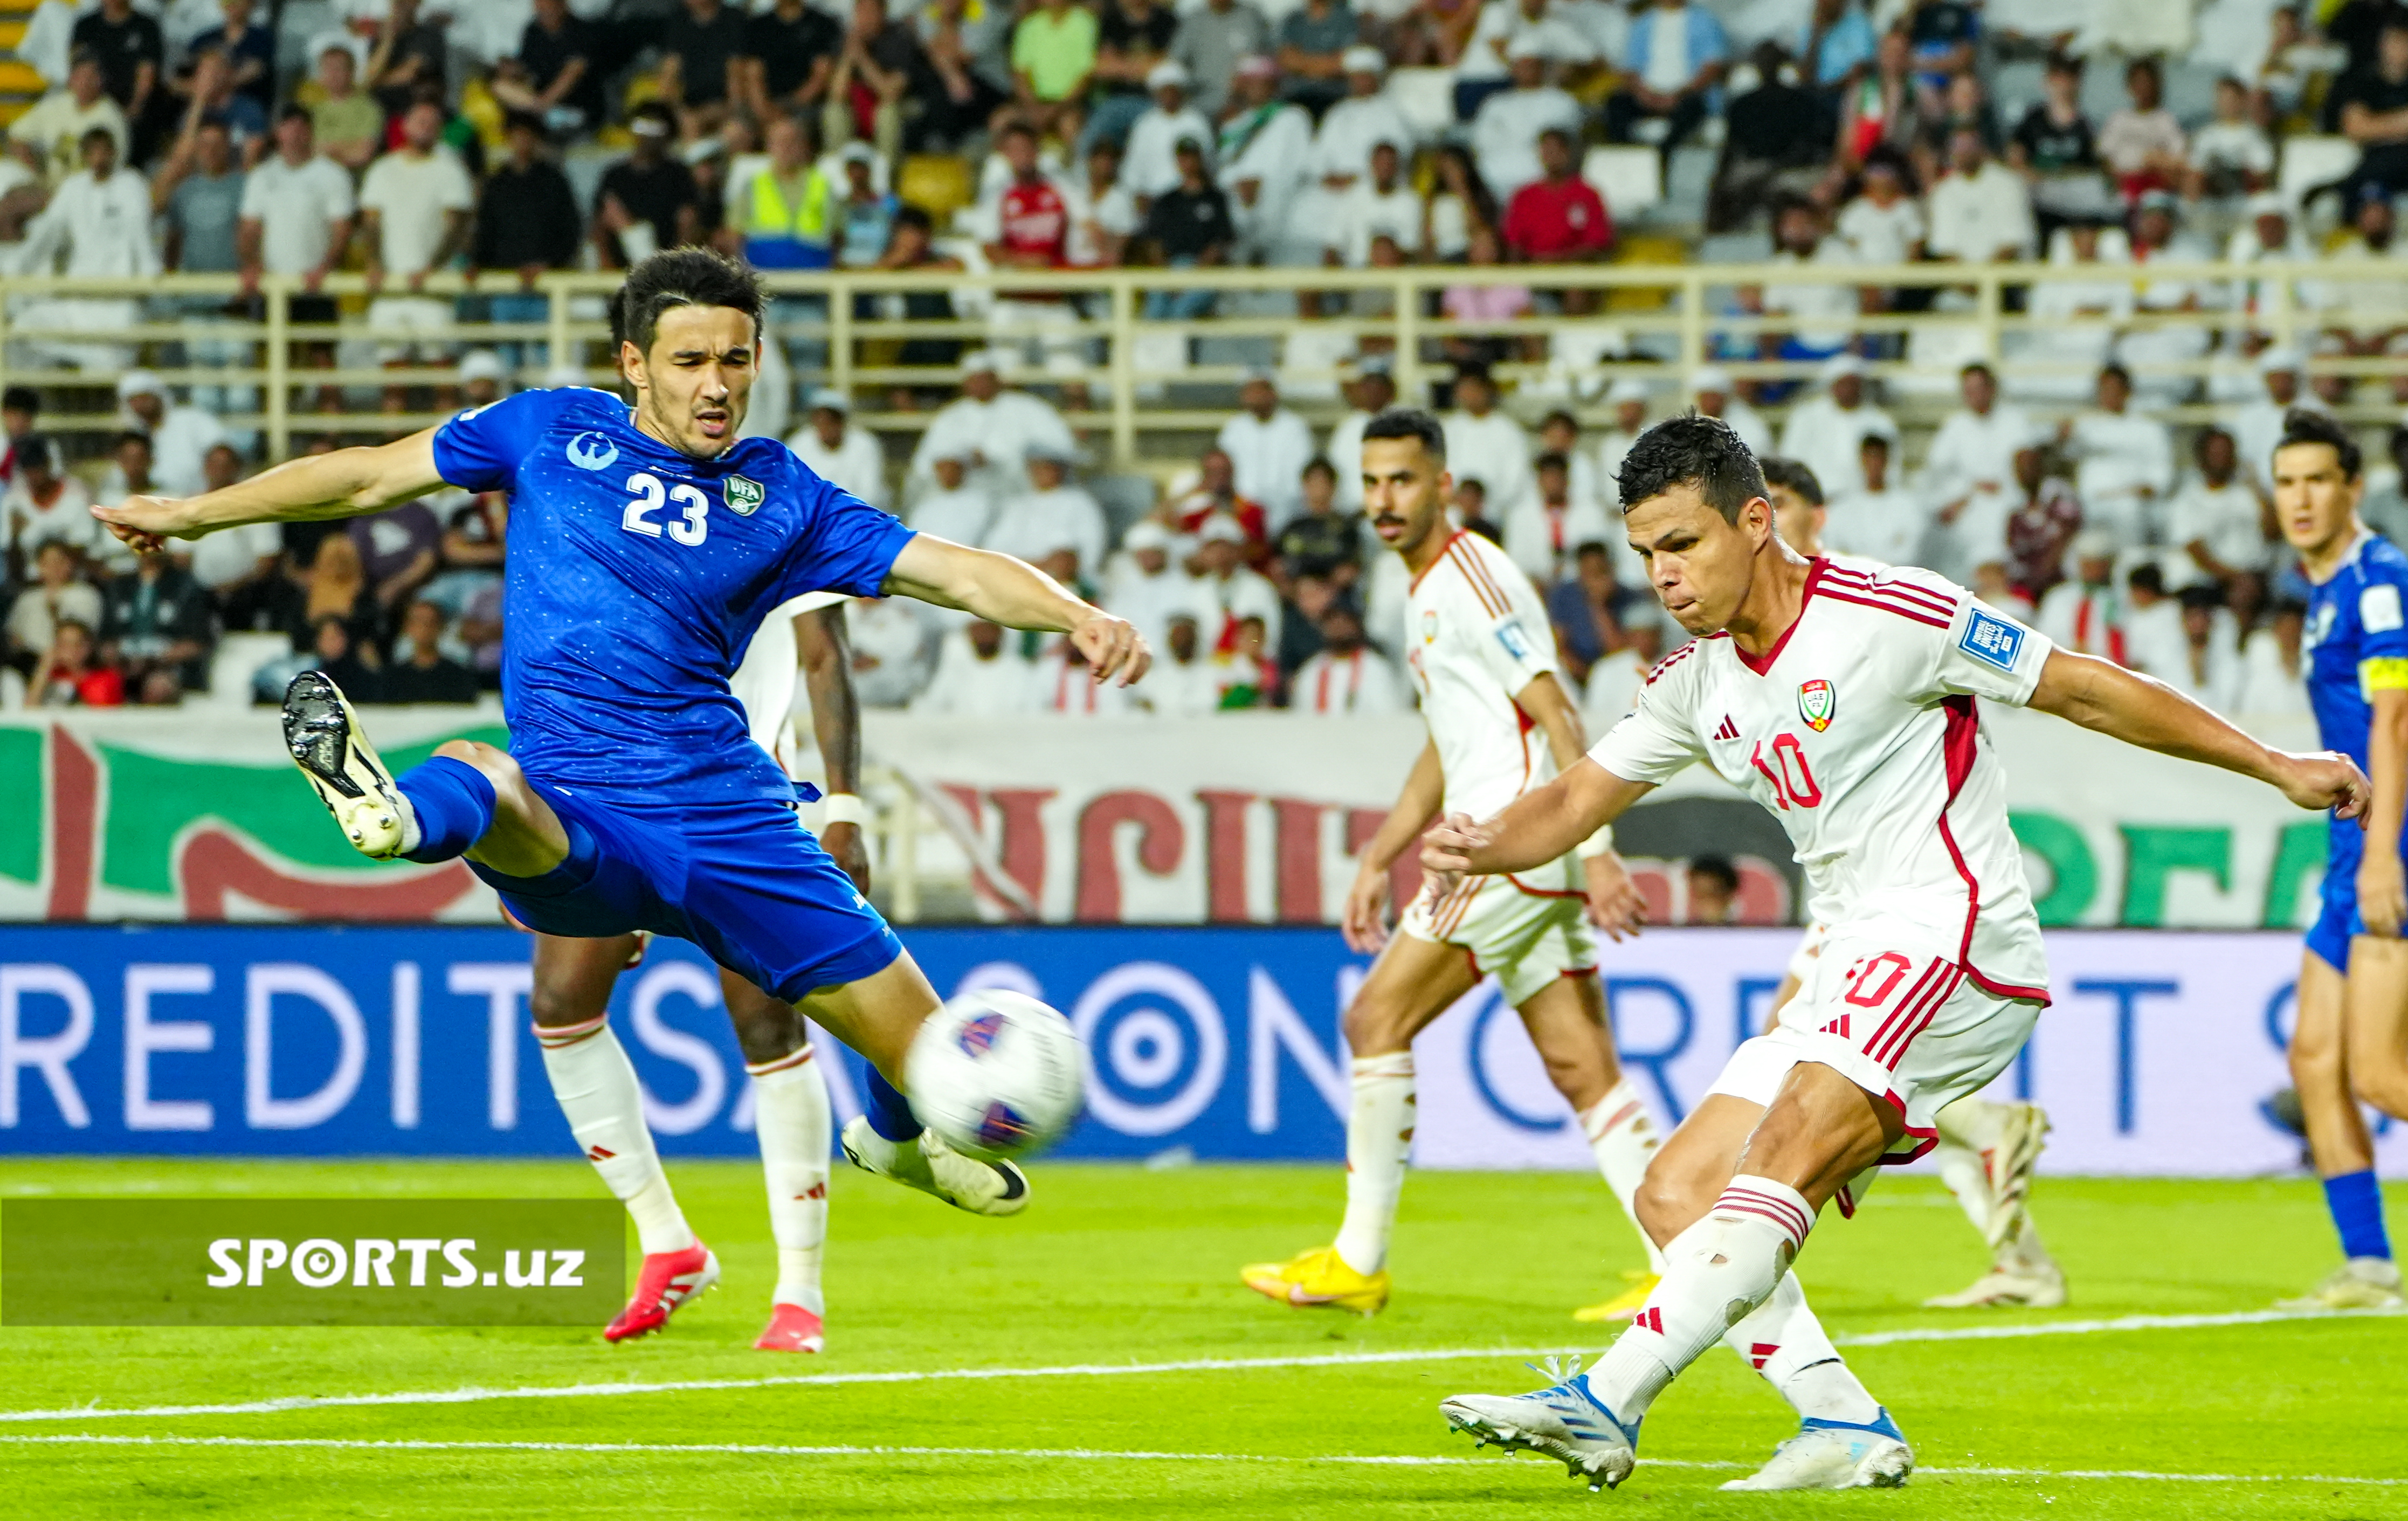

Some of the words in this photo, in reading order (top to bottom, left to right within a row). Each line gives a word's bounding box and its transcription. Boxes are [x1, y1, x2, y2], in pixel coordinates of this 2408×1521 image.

[622, 473, 709, 546] 23
[728, 478, 760, 500] UFA
[1979, 622, 1997, 649] UNITES
[1807, 693, 1824, 702] UAE
[1750, 732, 1823, 811] 10
[1845, 951, 1912, 1008] 0
